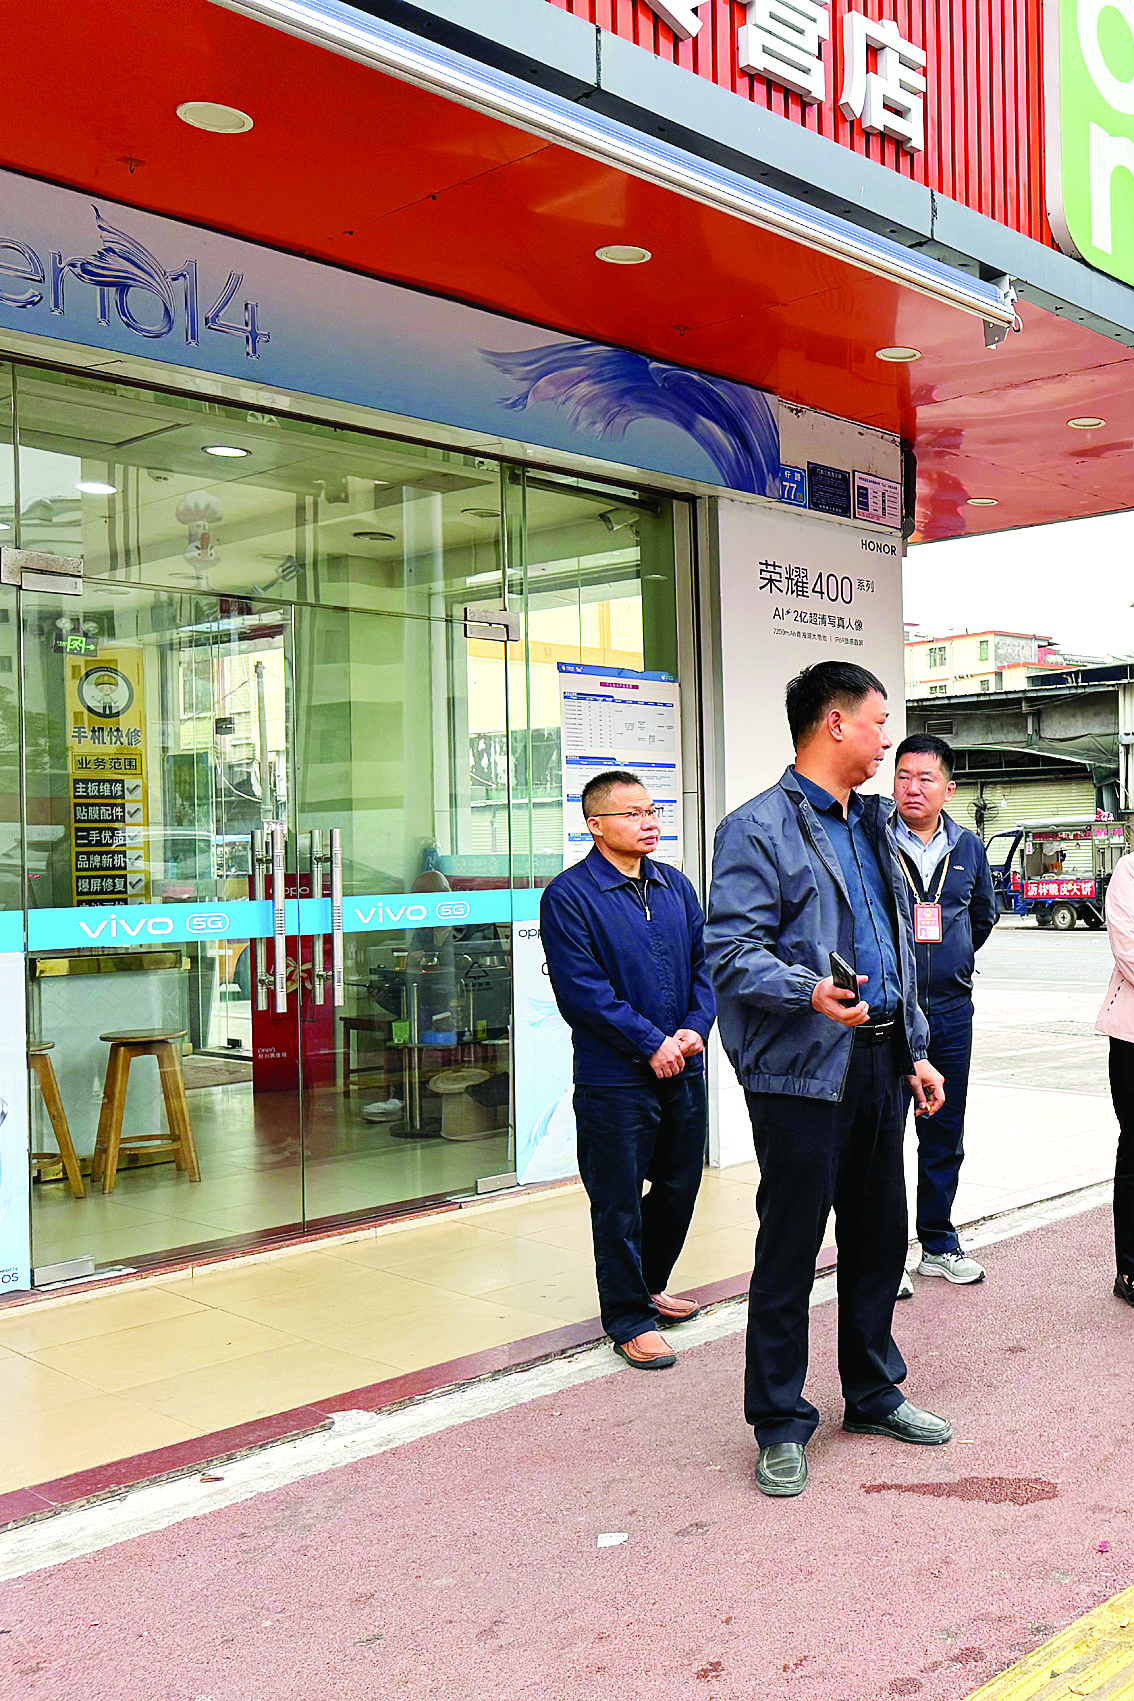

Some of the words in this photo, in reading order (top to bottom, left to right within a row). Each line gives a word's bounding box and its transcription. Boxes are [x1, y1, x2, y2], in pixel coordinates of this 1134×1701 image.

[643, 0, 926, 153] 营店
[783, 481, 797, 500] 77
[861, 539, 897, 556] HONOR
[856, 578, 875, 593] 系列
[71, 725, 142, 747] 手机快修
[77, 756, 137, 771] 业务范围
[75, 782, 123, 797] 主板维修
[76, 805, 124, 821] 贴膜配件
[76, 830, 124, 844] 二手优品
[77, 854, 126, 868] 品牌新机
[77, 878, 126, 893] 爆屏修复
[354, 901, 427, 924] vivo
[440, 904, 465, 916] 5G
[79, 913, 174, 939] vivo
[191, 916, 224, 930] 5G
